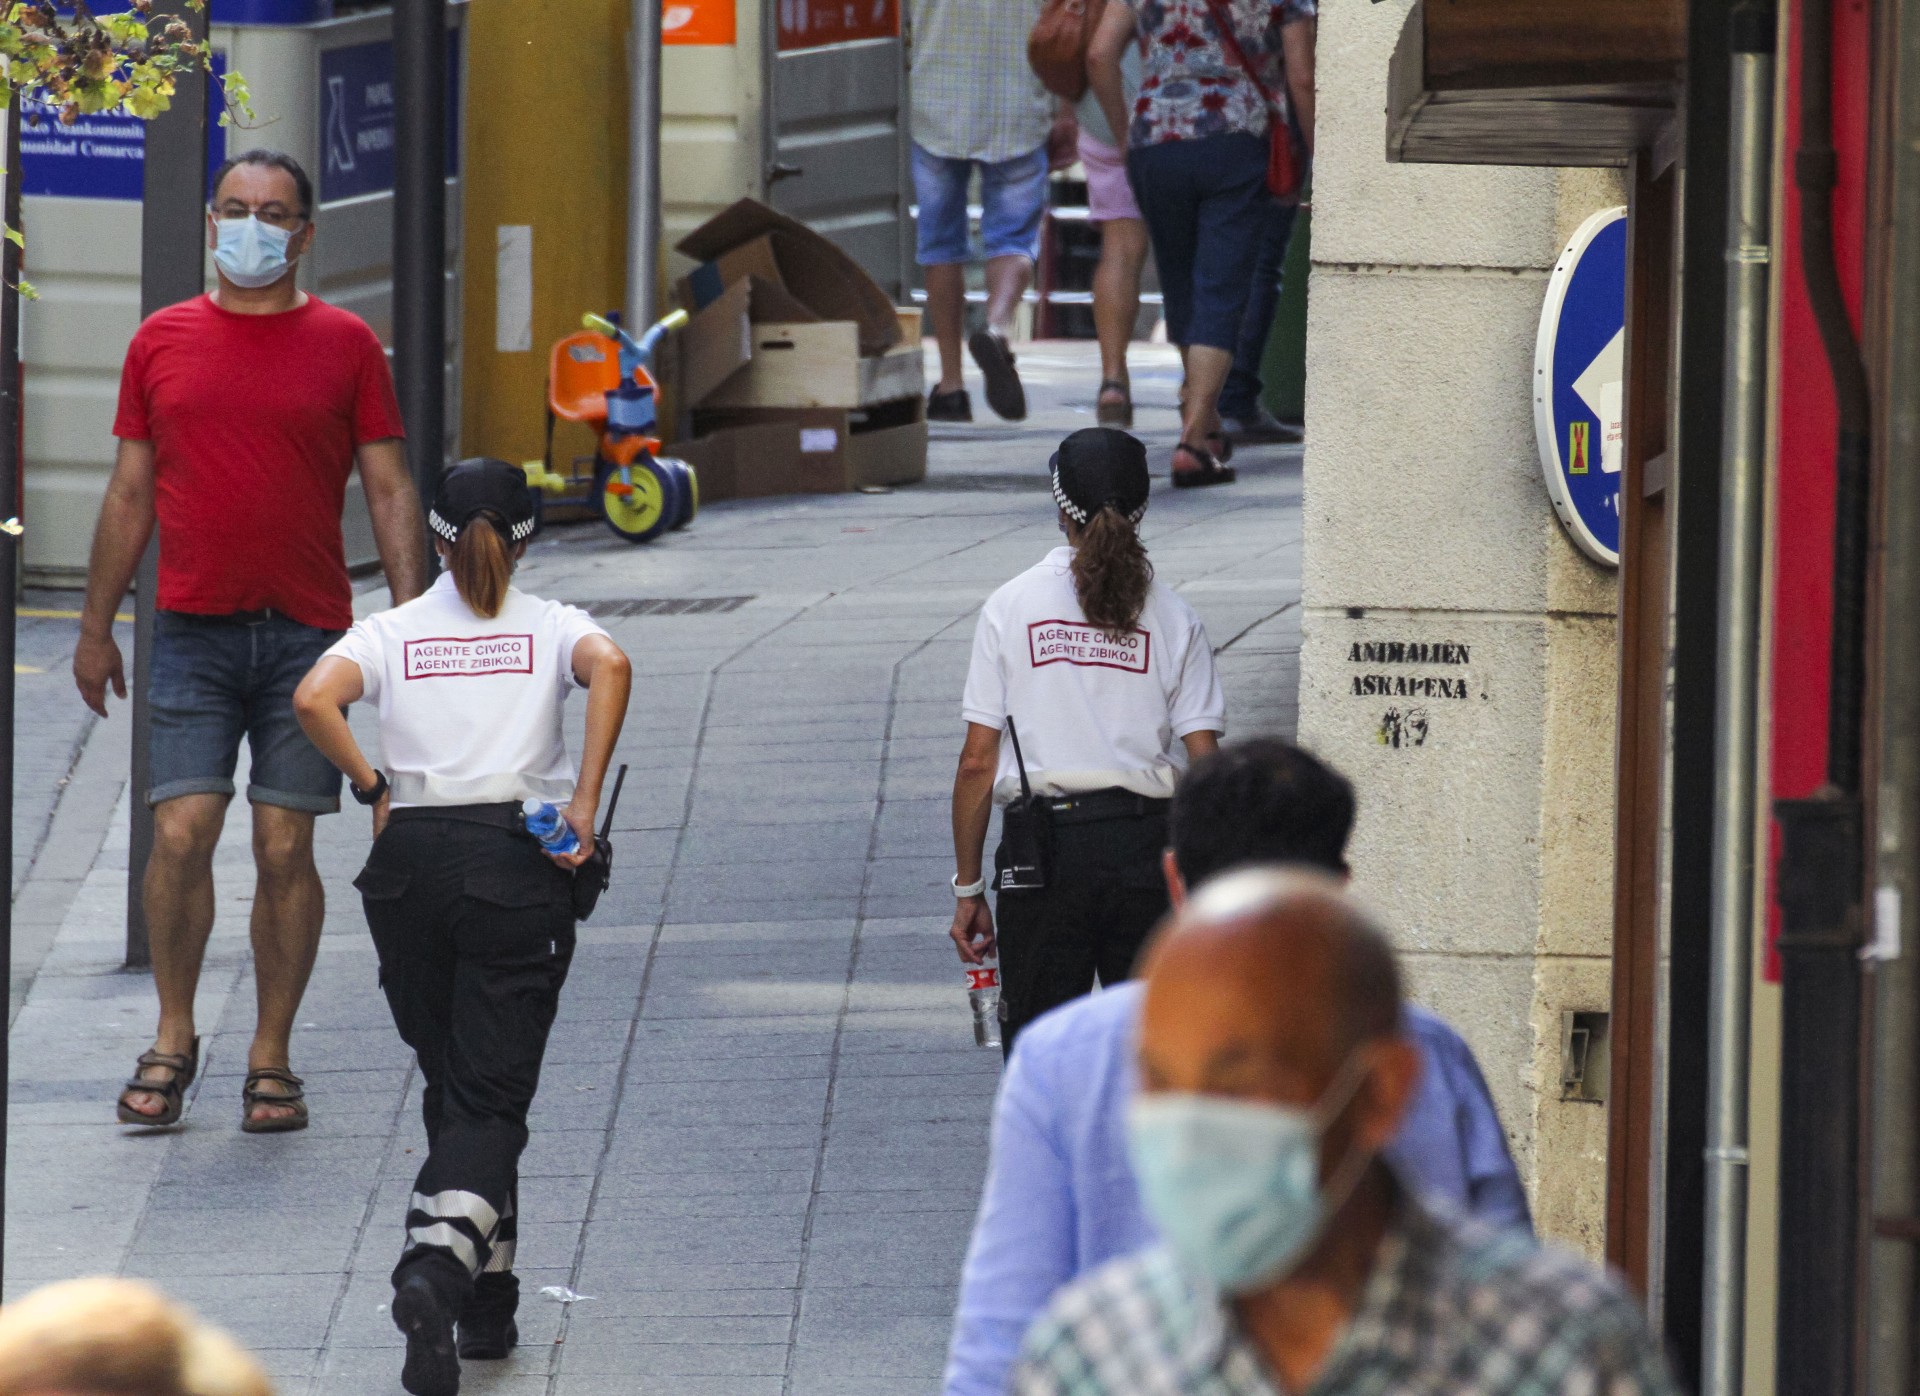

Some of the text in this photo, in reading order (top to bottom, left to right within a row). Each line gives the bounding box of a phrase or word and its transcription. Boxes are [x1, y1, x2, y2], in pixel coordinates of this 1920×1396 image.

[1038, 629, 1138, 649] AGENTE CIVICO
[414, 642, 521, 658] AGENTE CIVICO
[1040, 643, 1137, 663] AGENTE ZIBIKOA
[1348, 641, 1470, 664] ANIMALIEN
[415, 656, 522, 671] AGENTE ZIBIKOA
[1350, 675, 1467, 699] ASKAPENA
